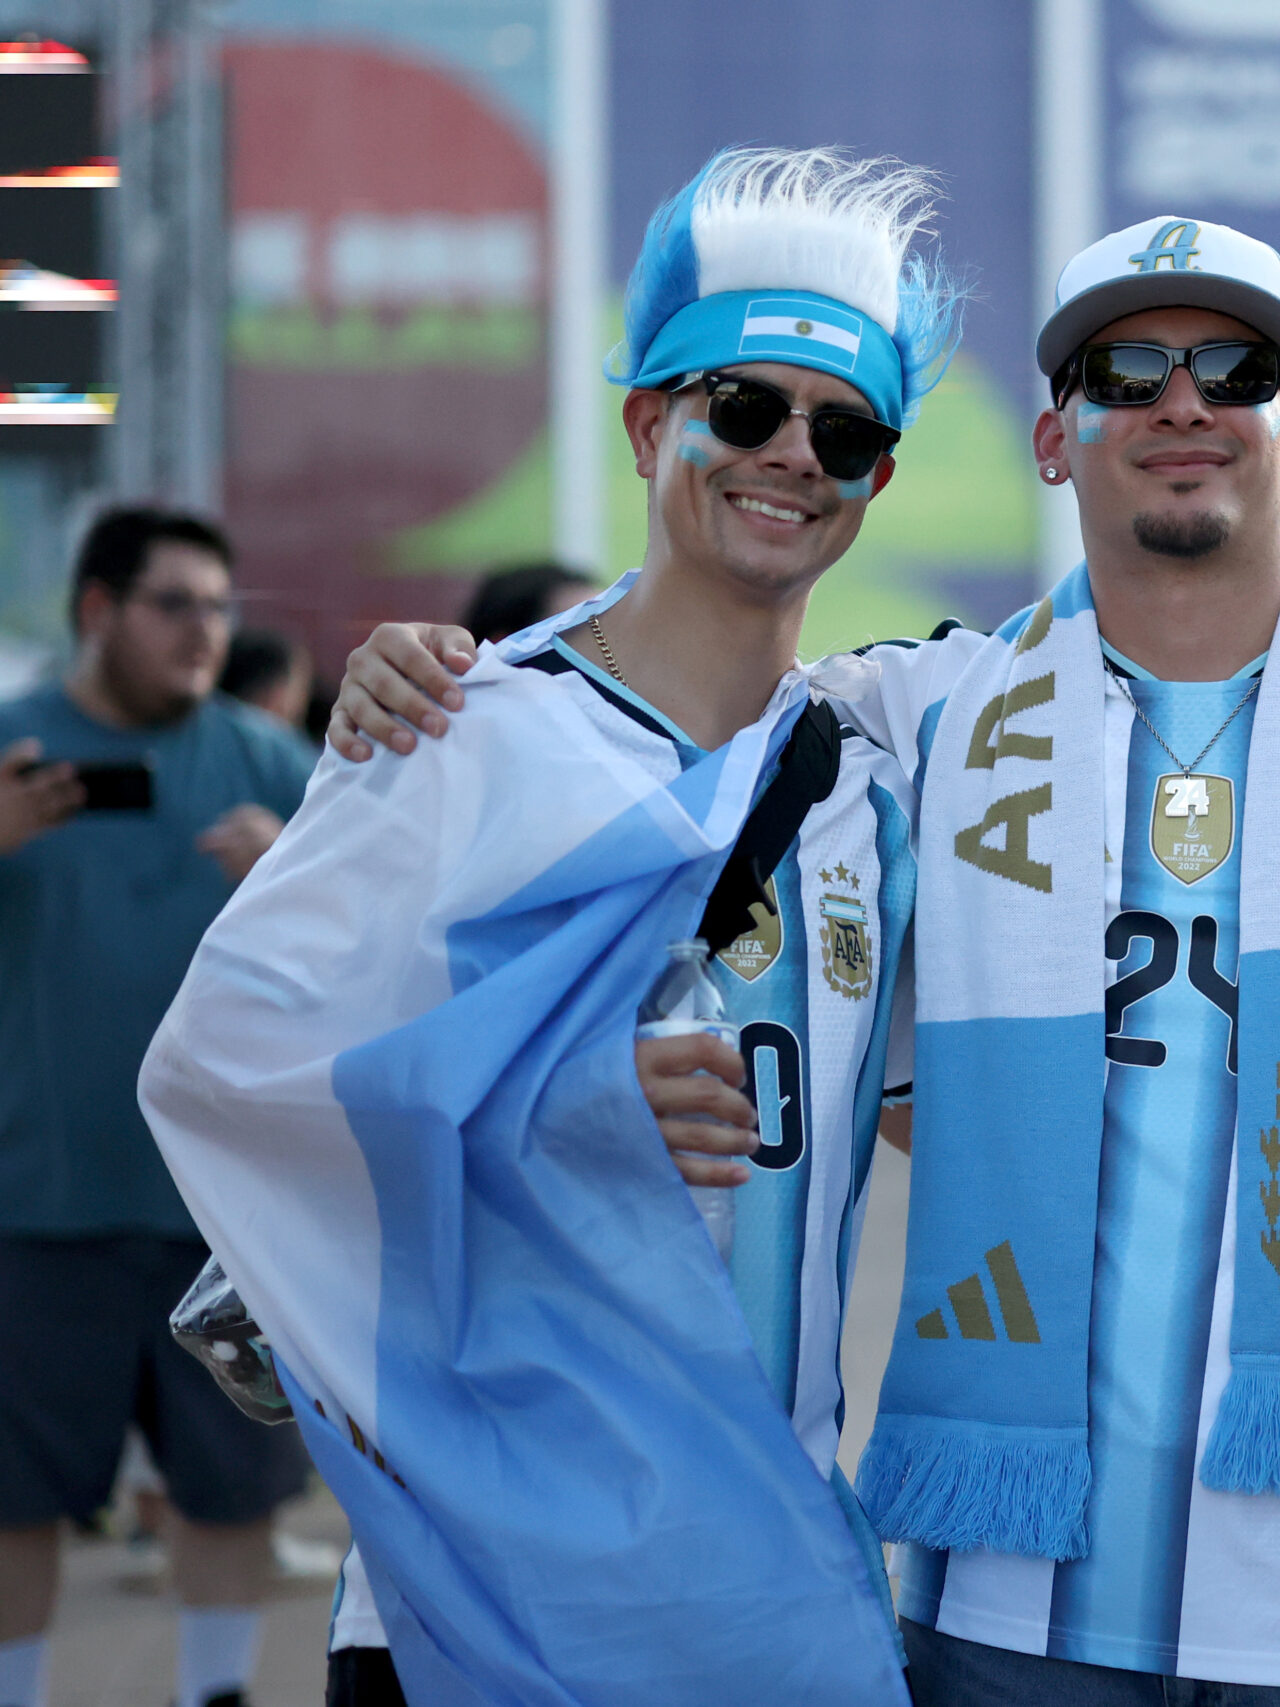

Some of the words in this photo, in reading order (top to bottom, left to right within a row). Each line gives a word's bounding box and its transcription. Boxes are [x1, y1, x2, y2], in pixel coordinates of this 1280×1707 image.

[1164, 778, 1210, 817] 24
[1173, 842, 1210, 857] FIFA
[1178, 862, 1200, 871] 2022
[730, 939, 764, 954] FIFA
[834, 921, 865, 971] AFA
[737, 959, 757, 968] 2022
[1105, 910, 1240, 1077] 24
